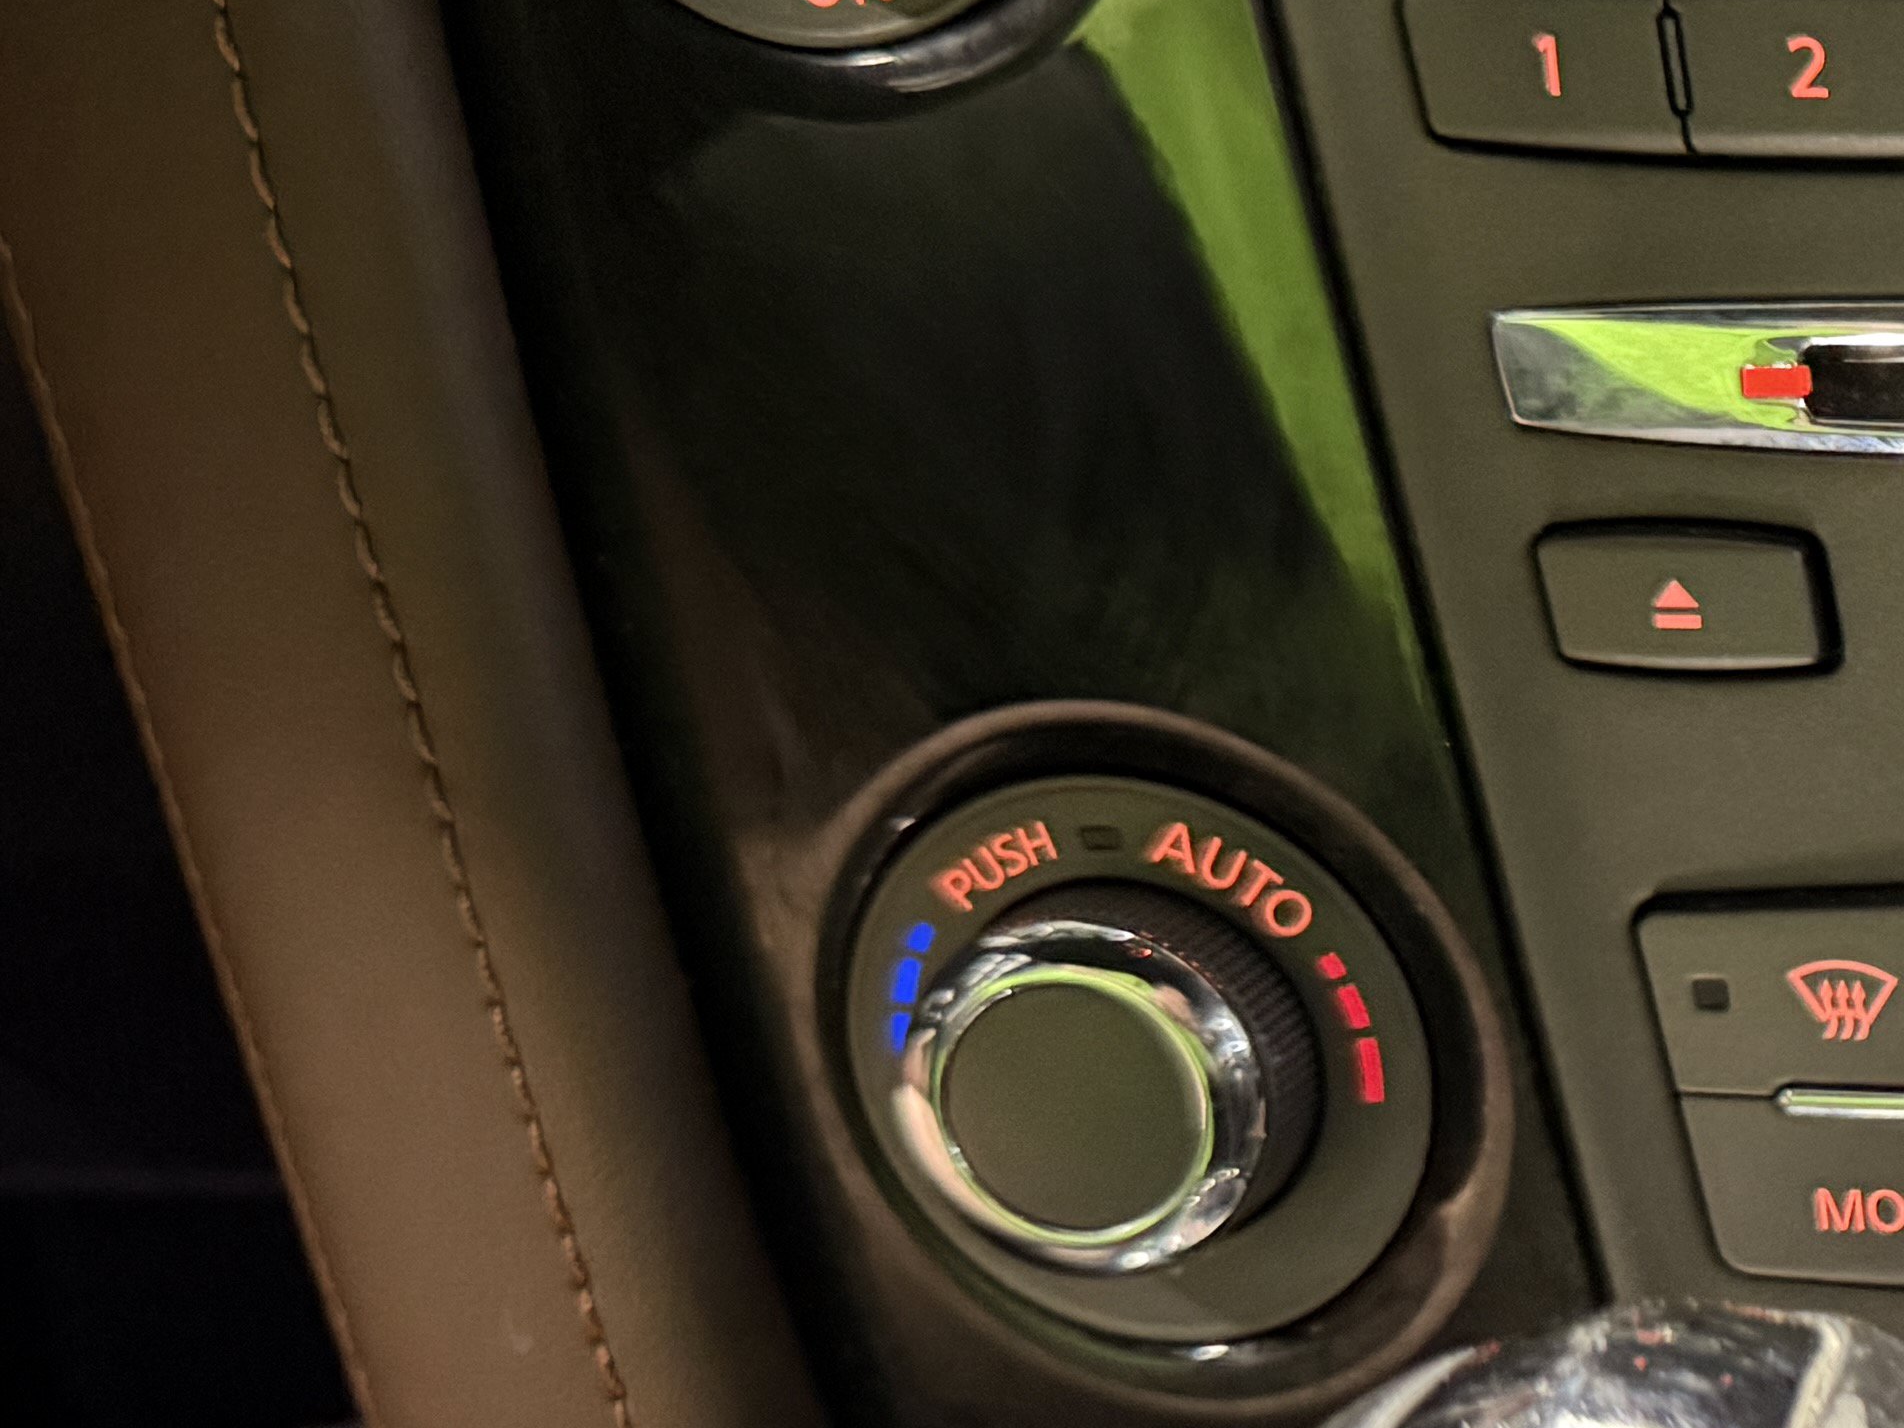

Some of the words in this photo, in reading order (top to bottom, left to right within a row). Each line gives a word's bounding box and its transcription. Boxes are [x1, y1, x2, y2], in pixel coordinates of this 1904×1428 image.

[1532, 32, 1564, 98] 1
[1785, 34, 1831, 102] 2
[930, 820, 1059, 913] PUSH
[1147, 821, 1314, 939] AUTO
